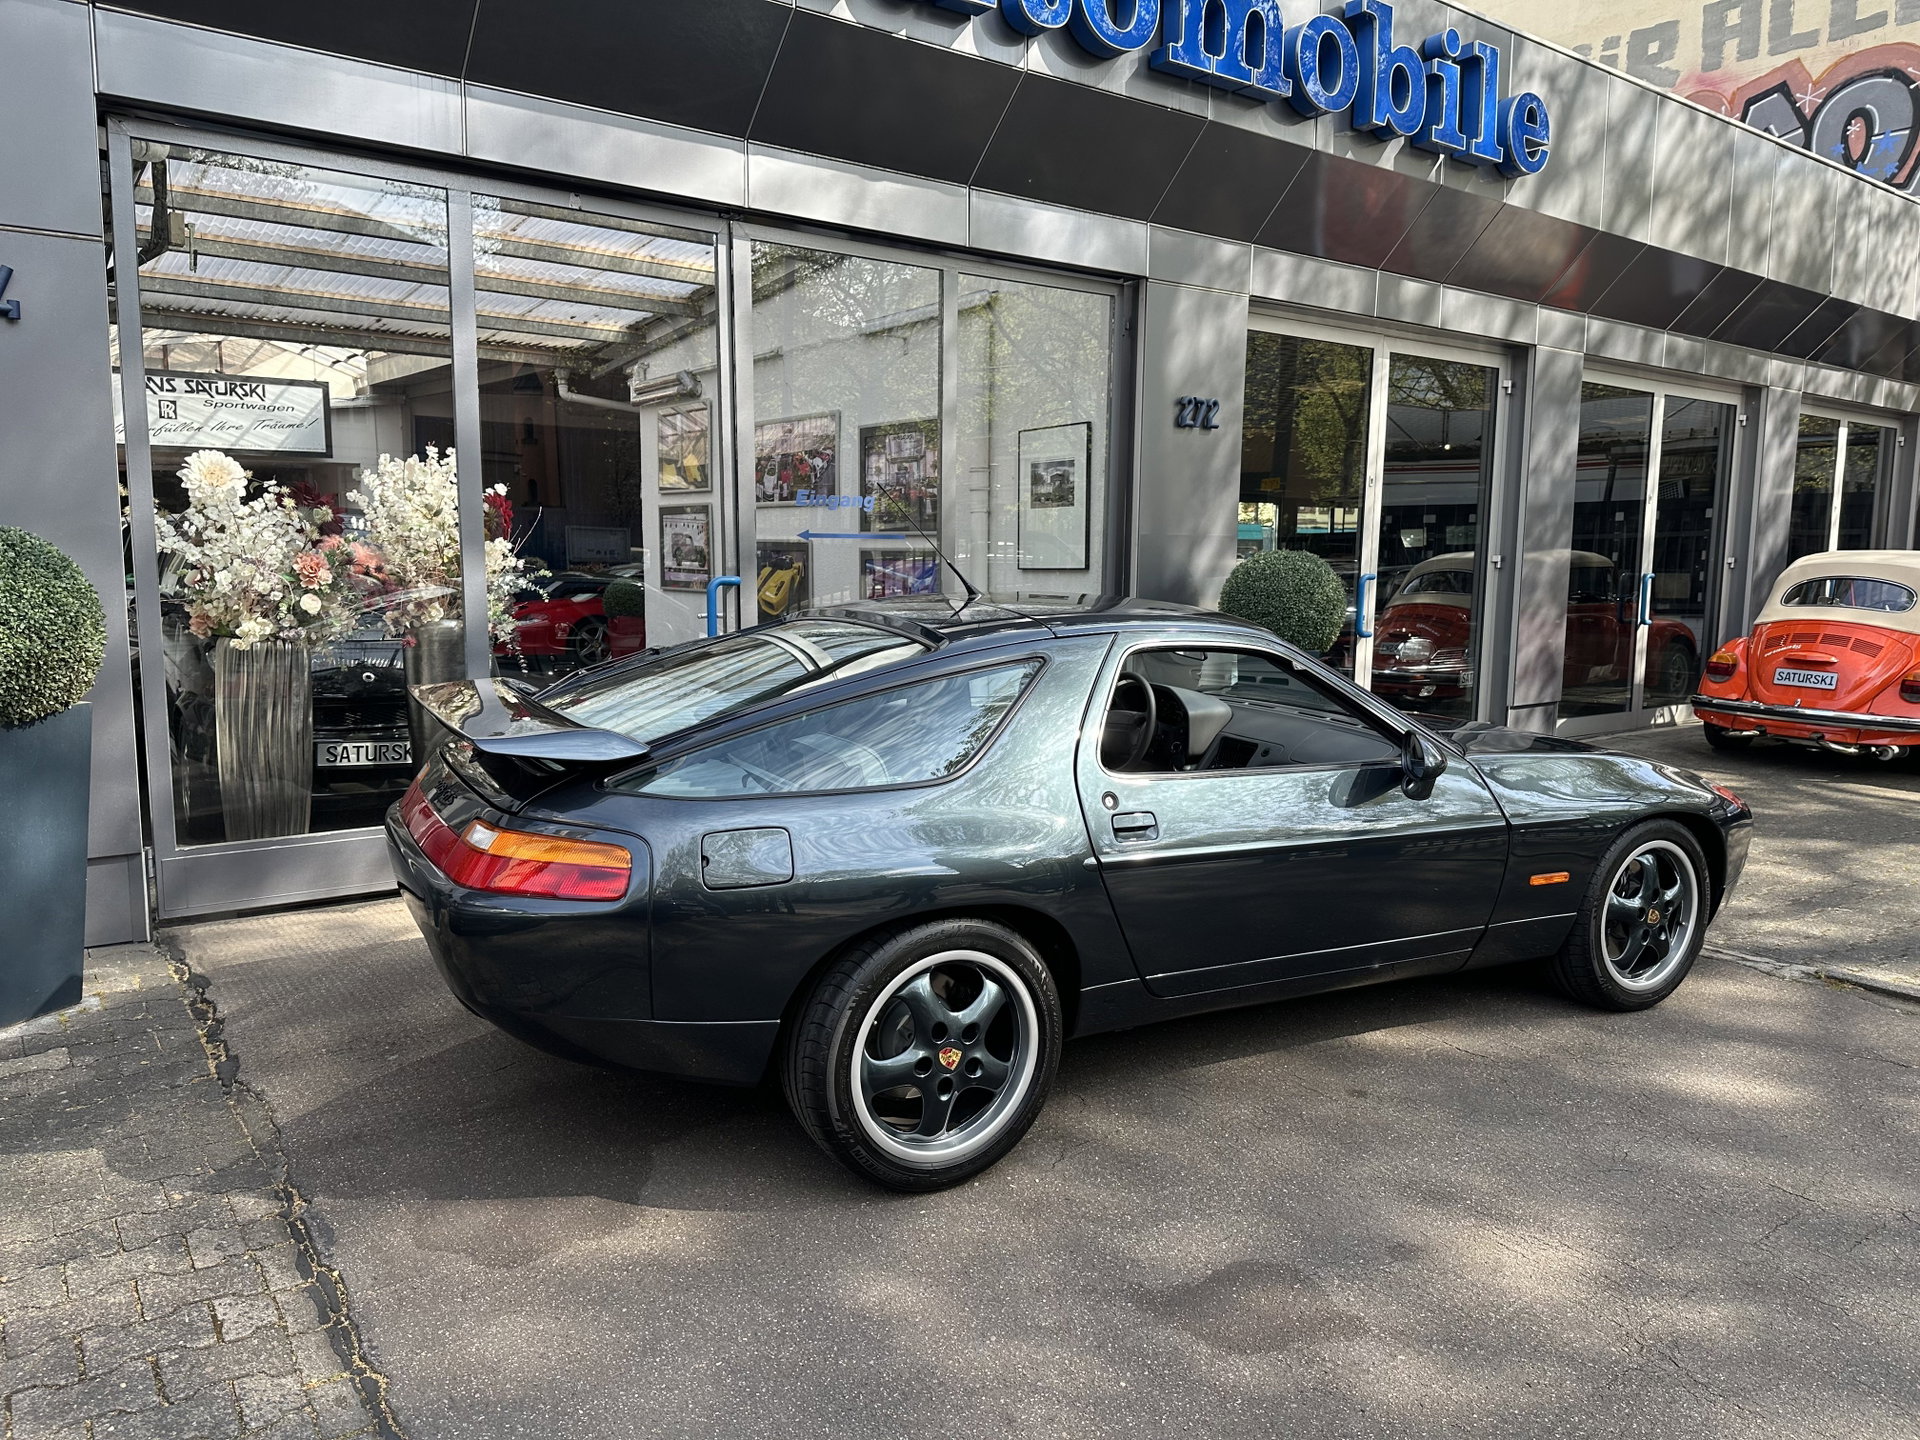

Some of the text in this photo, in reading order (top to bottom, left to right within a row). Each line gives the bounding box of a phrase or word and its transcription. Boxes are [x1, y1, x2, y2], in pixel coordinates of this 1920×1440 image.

[184, 379, 266, 402] SATURSKI
[203, 399, 295, 413] Sportwagen
[1178, 396, 1220, 429] 272
[148, 421, 204, 437] rfüllen
[253, 417, 320, 431] Träume!
[795, 489, 876, 511] Eingang
[1776, 671, 1835, 687] SATURSKI
[325, 743, 413, 763] SATURSK
